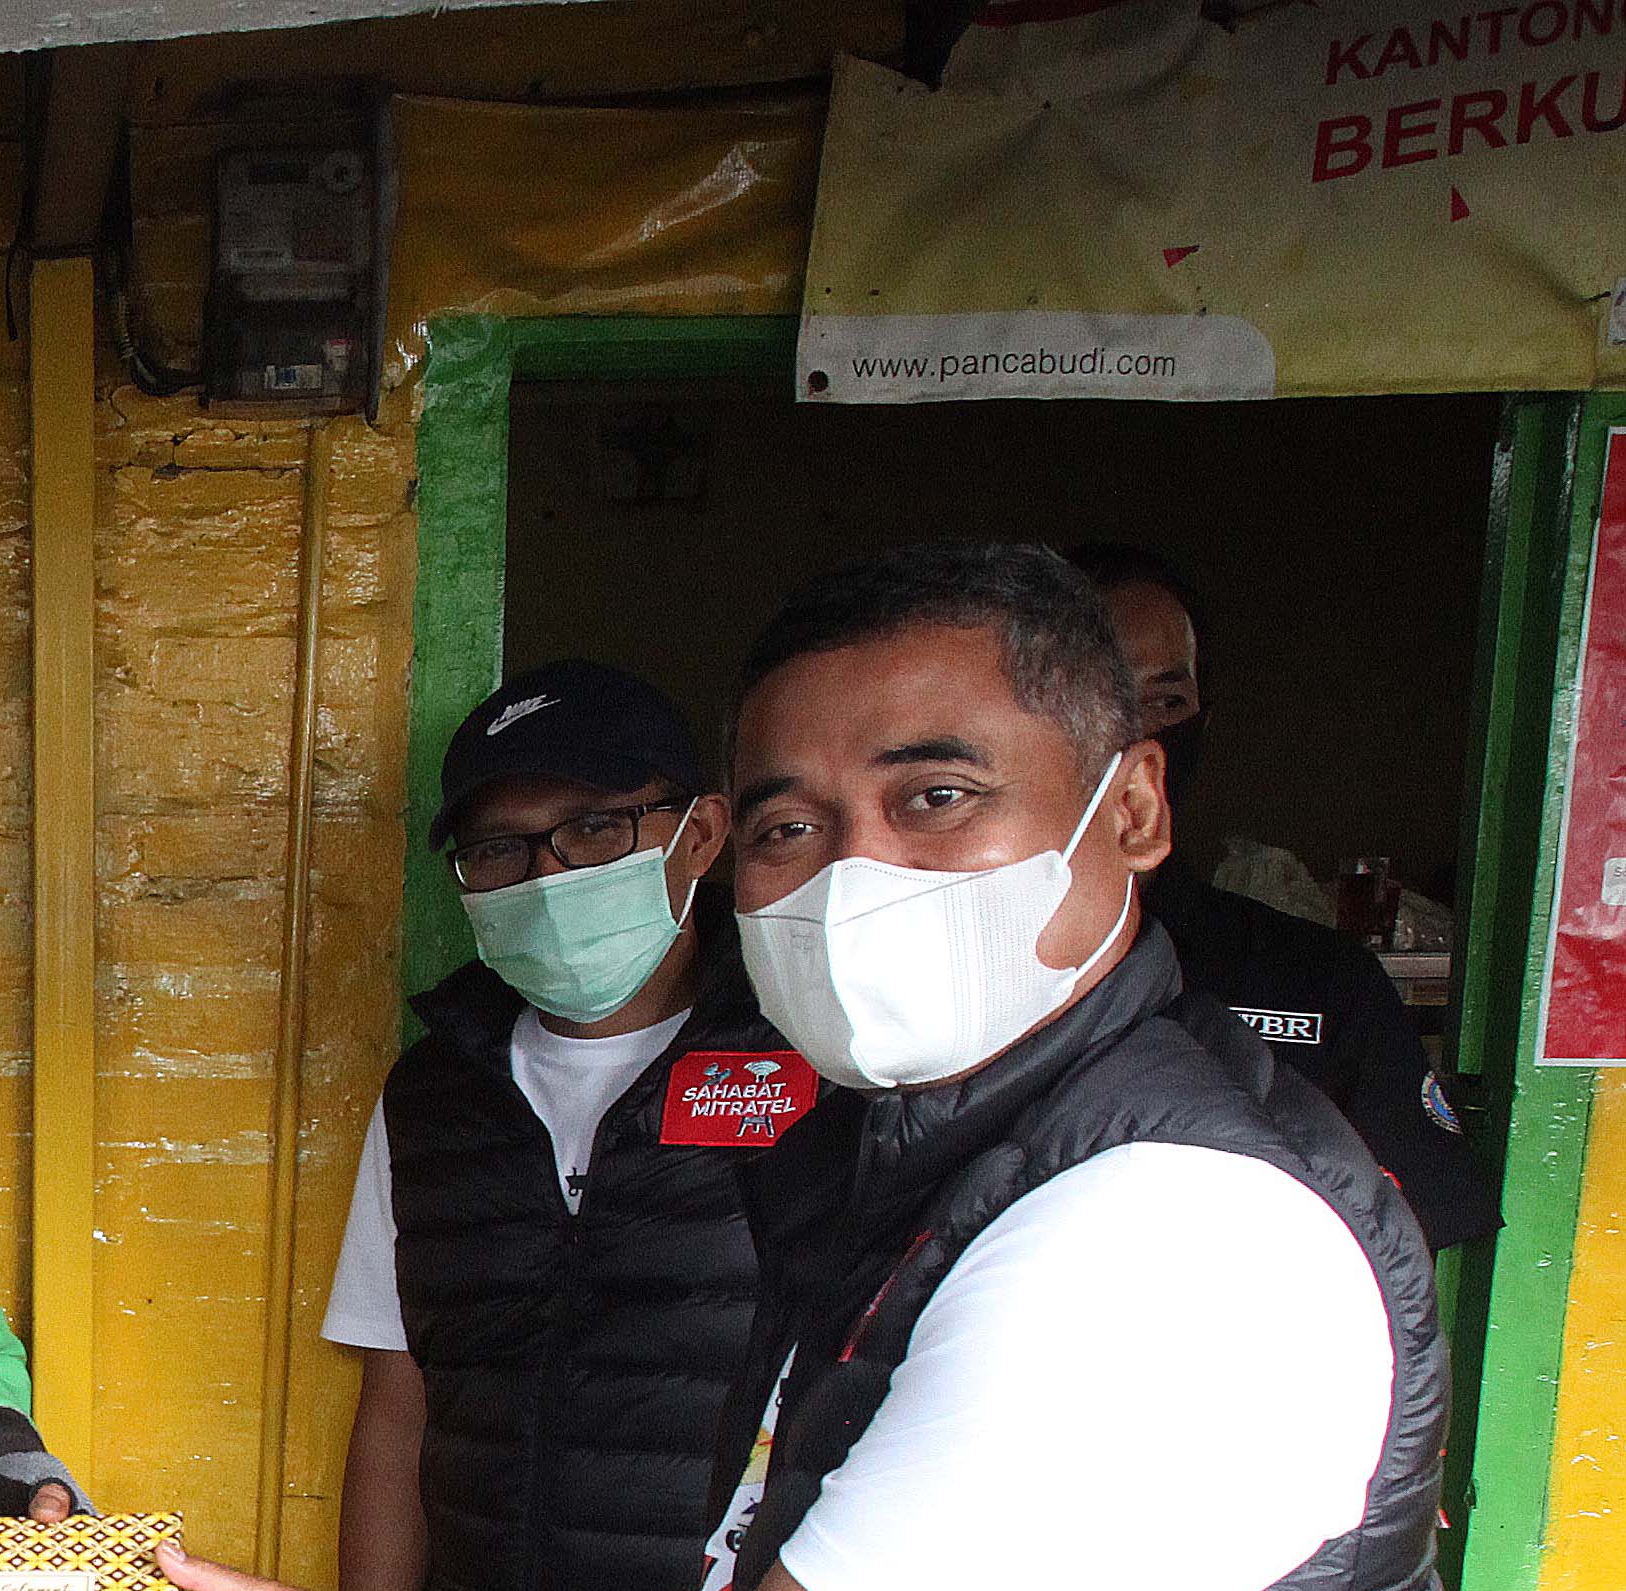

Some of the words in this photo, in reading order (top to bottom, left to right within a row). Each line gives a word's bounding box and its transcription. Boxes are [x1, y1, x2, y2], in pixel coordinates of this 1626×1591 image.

[1325, 0, 1626, 85] KANTON
[852, 348, 1176, 383] www.pancabudi.com
[682, 1082, 787, 1102] SAHABAT
[690, 1097, 797, 1118] MITRATEL
